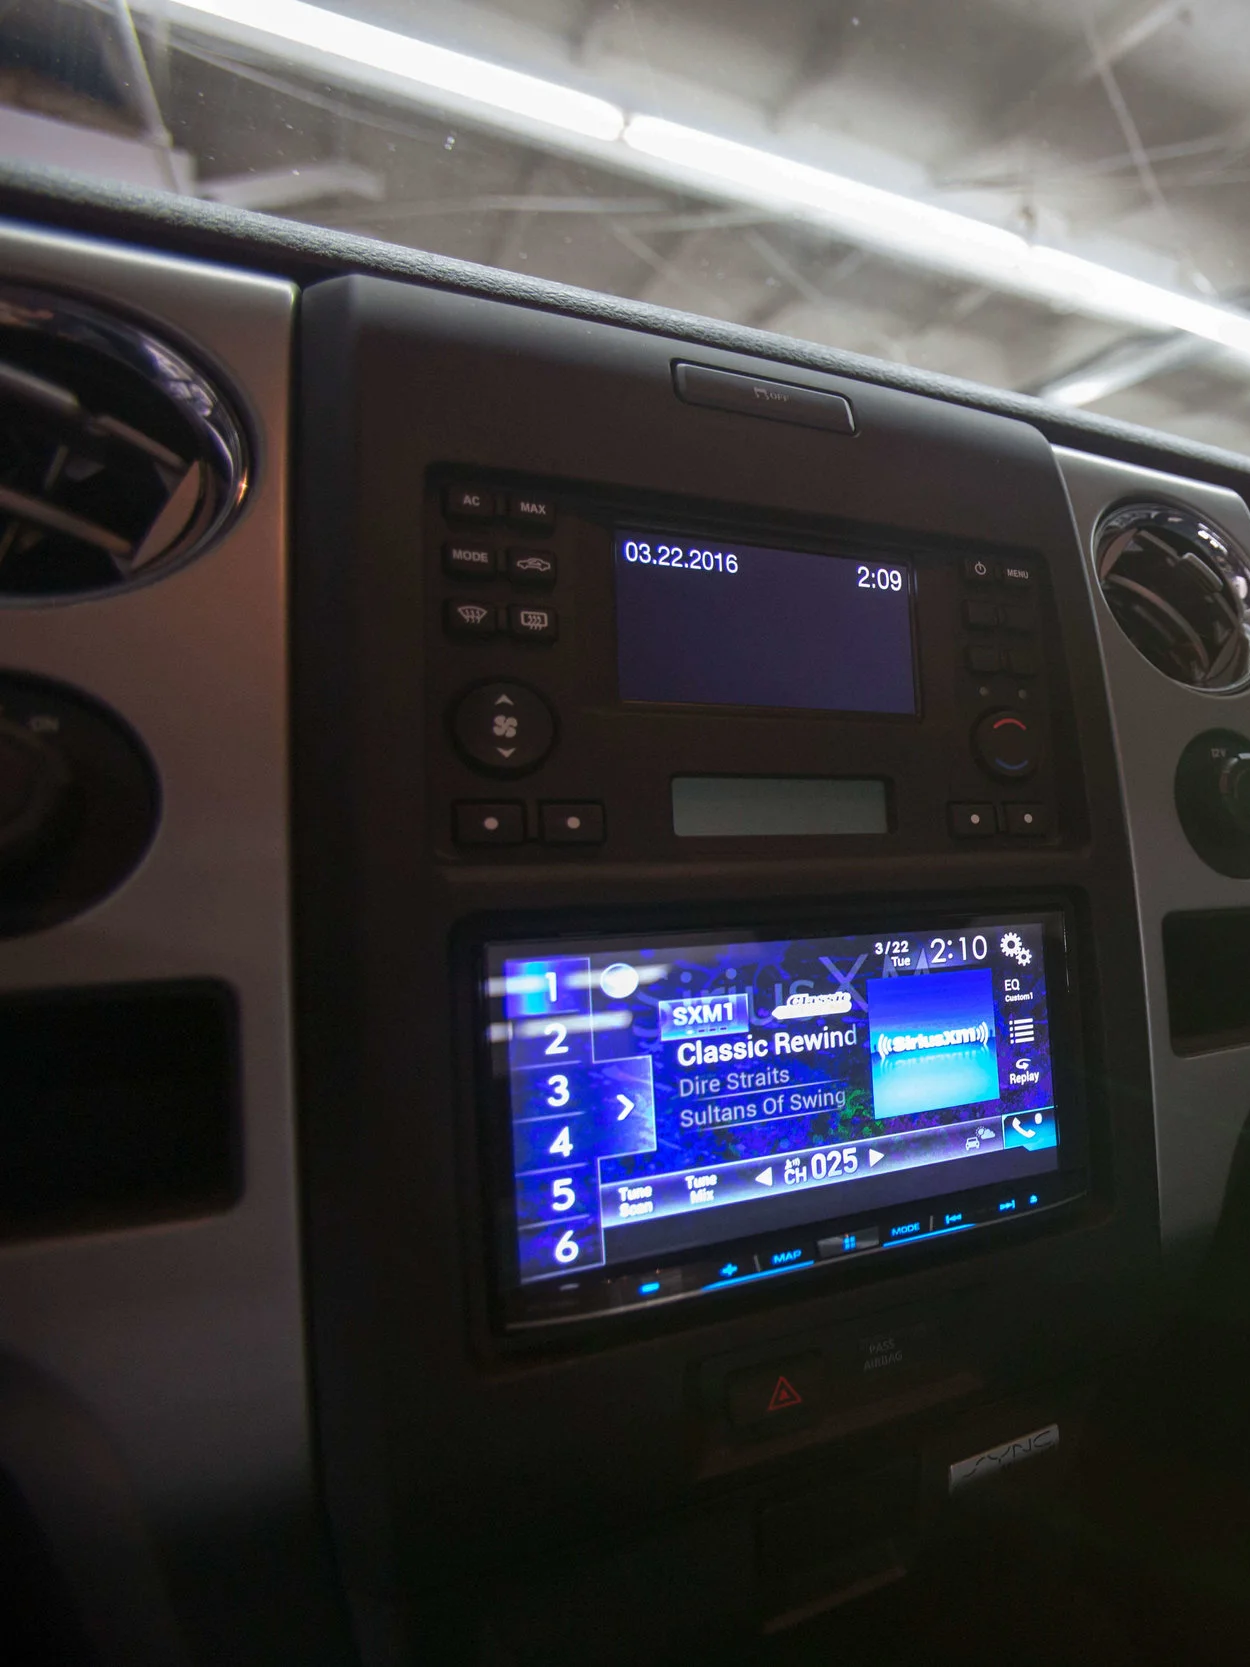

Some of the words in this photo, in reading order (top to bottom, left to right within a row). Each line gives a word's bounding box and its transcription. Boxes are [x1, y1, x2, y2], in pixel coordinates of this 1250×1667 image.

[463, 495, 480, 506] AC
[520, 502, 546, 515] MAX
[452, 549, 488, 563] MODE
[624, 541, 739, 574] 03.22.2016
[857, 565, 903, 591] 2:09
[1007, 568, 1029, 580] MENU
[874, 940, 910, 956] 3/22
[929, 934, 988, 964] 2:10
[891, 955, 911, 967] Tue
[545, 971, 558, 1002] 1
[1004, 978, 1021, 992] EQ
[1004, 991, 1034, 1003] Custom1
[672, 1002, 734, 1027] SXM1
[543, 1022, 569, 1055] 2
[676, 1034, 769, 1067] Classic
[773, 1023, 857, 1056] Rewind
[546, 1073, 571, 1107] 3
[679, 1076, 720, 1098] Dire
[726, 1067, 790, 1092] Straits
[1009, 1071, 1040, 1086] Replay
[680, 1102, 757, 1129] Sultans
[762, 1094, 784, 1116] Of
[789, 1089, 846, 1111] Swing
[548, 1125, 574, 1158] 4
[784, 1165, 807, 1186] CH
[811, 1147, 859, 1181] 025
[618, 1185, 653, 1202] Tune
[685, 1174, 718, 1190] Tune
[551, 1178, 577, 1212] 5
[891, 1221, 921, 1237] MODE
[554, 1229, 580, 1263] 6
[772, 1249, 802, 1265] MAP
[963, 1430, 1052, 1480] SYNC
